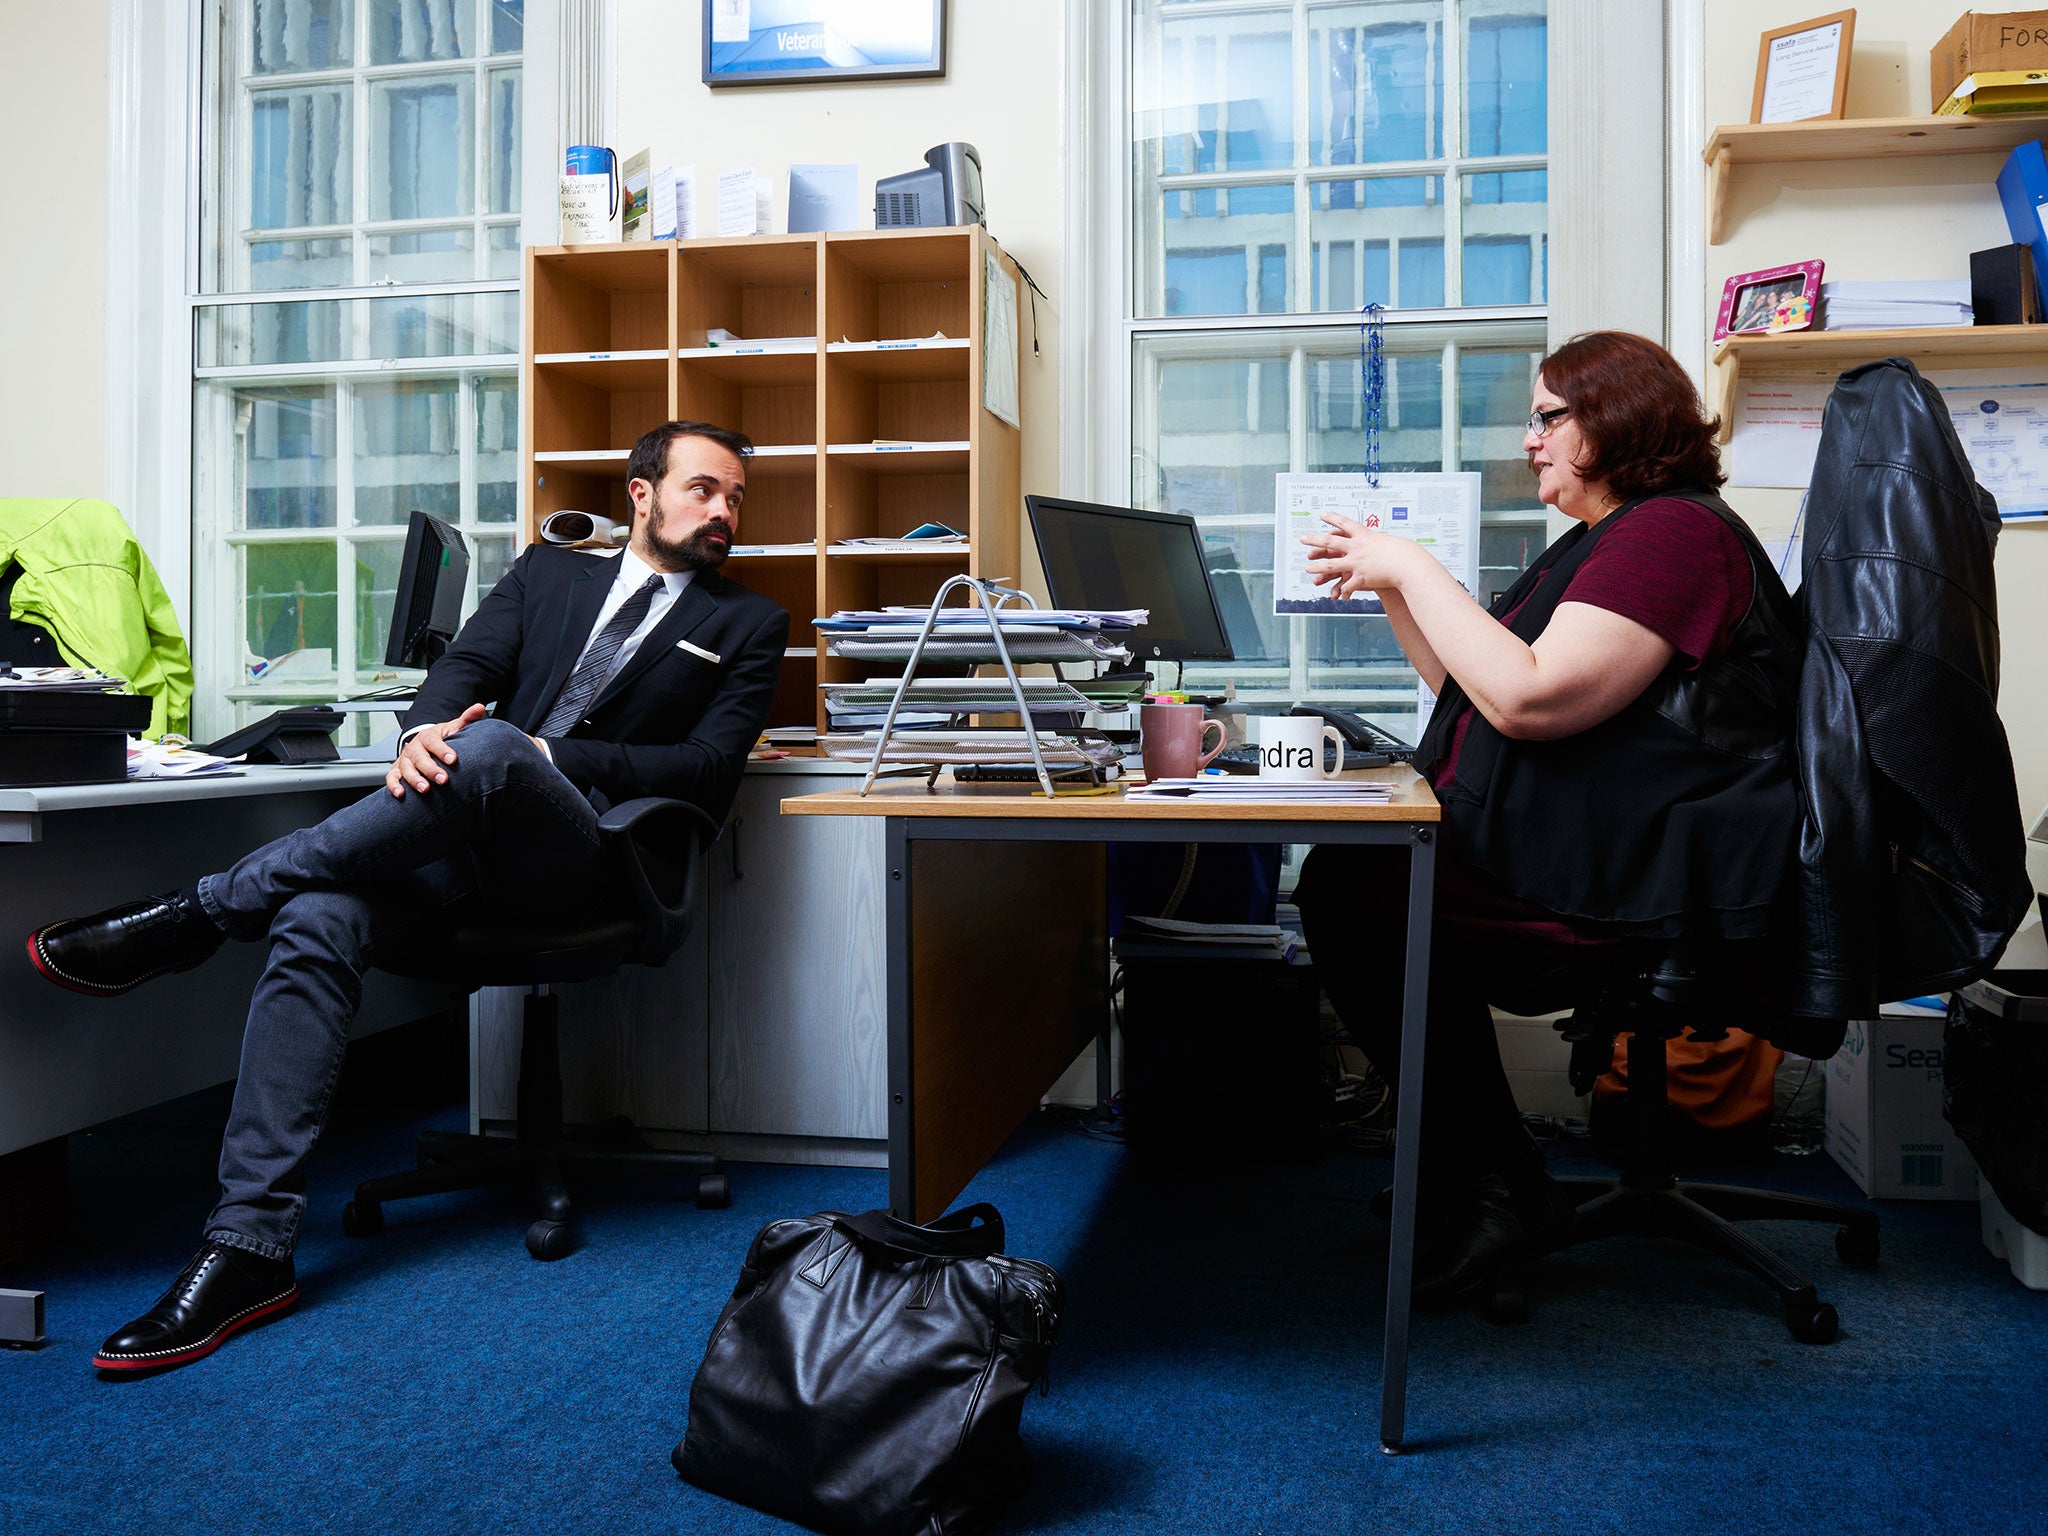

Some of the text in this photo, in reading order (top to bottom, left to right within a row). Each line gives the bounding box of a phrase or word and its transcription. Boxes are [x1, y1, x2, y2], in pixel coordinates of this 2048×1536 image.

[777, 31, 827, 52] Veteran
[2000, 26, 2048, 48] FOR
[1887, 1044, 1943, 1068] Sea
